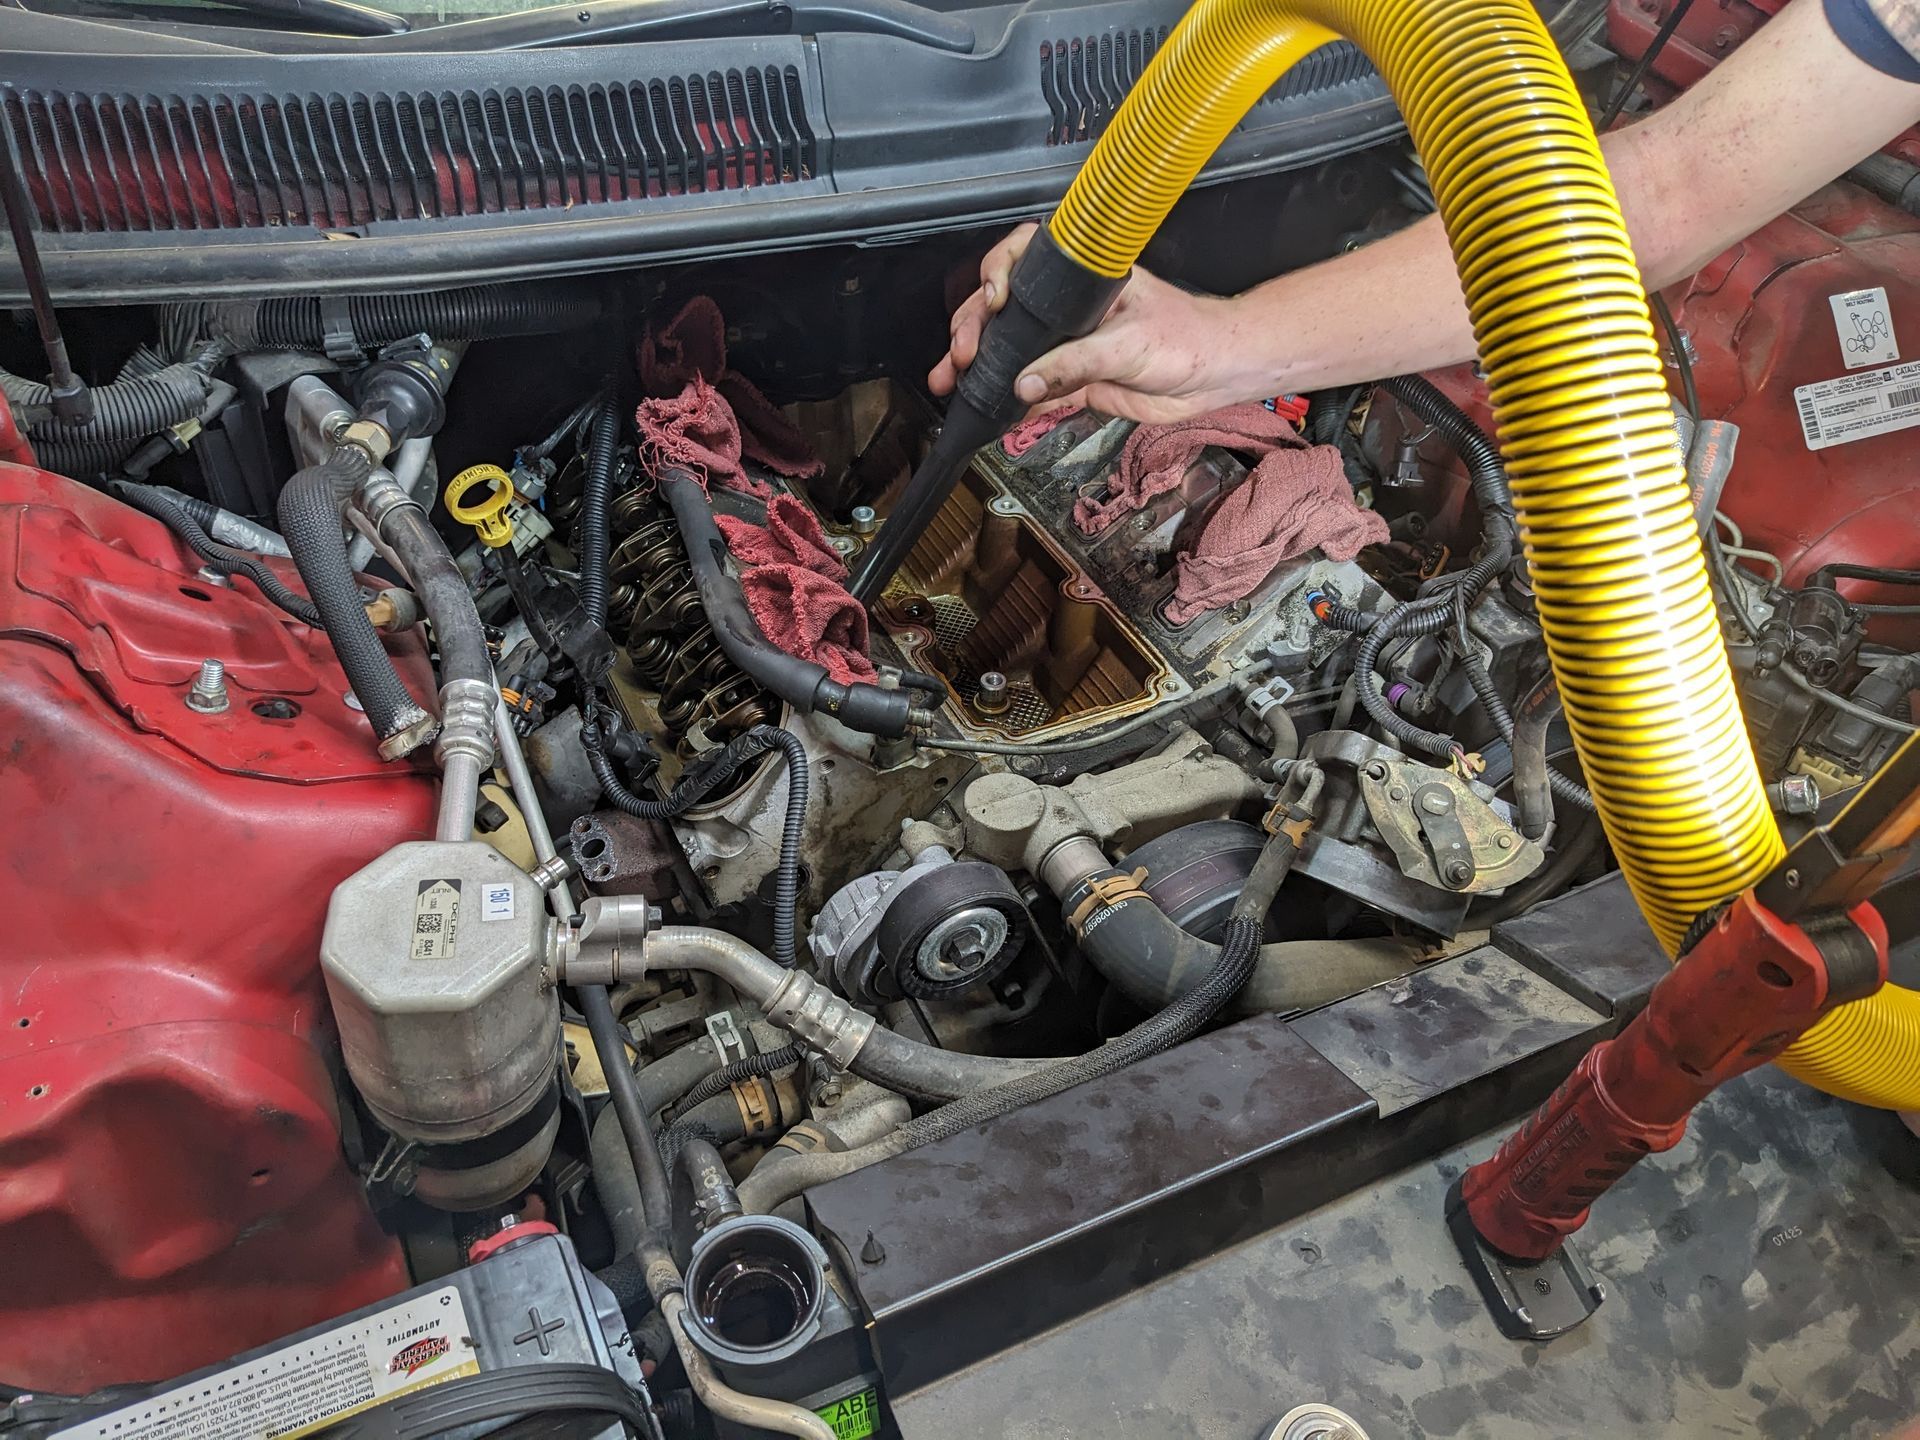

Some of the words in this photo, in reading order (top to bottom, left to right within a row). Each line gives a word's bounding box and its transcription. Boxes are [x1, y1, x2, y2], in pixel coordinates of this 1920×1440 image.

[490, 888, 510, 904] 150
[448, 902, 458, 944] DELPHI
[424, 940, 434, 956] 8341
[385, 1318, 442, 1346] AUTOMOTIVE
[336, 1346, 356, 1358] limited
[358, 1350, 367, 1358] To
[391, 1337, 447, 1364] BATTERIES
[335, 1352, 359, 1367] replace
[390, 1344, 450, 1373] INTERSTATE
[316, 1362, 336, 1374] under
[332, 1359, 369, 1379] Distributed
[287, 1368, 317, 1385] warranty,
[322, 1372, 333, 1383] by
[344, 1369, 371, 1384] chemicals
[354, 1376, 373, 1388] known
[217, 1384, 226, 1392] AP
[267, 1383, 281, 1393] U.S.
[280, 1380, 288, 1388] in
[292, 1377, 324, 1395] Interstate
[326, 1380, 345, 1392] known
[338, 1386, 348, 1394] the
[355, 1383, 374, 1396] Battery
[256, 1388, 268, 1398] call
[261, 1389, 292, 1406] Batteries,
[296, 1393, 310, 1403] state
[310, 1389, 320, 1398] the
[324, 1390, 338, 1400] state
[238, 1400, 261, 1415] Dallas,
[264, 1401, 291, 1416] California
[292, 1398, 319, 1412] California
[313, 1398, 339, 1412] terminals
[319, 1391, 376, 1418] PROPOSITION
[836, 1390, 877, 1421] ABE
[177, 1405, 203, 1419] Interstate
[200, 1411, 208, 1419] in
[228, 1410, 238, 1419] TX
[283, 1412, 302, 1424] related
[302, 1408, 313, 1417] and
[175, 1413, 201, 1429] Canada
[205, 1414, 229, 1428] 75251
[308, 1414, 319, 1423] 65
[163, 1423, 176, 1434] call
[189, 1422, 206, 1434] USA
[206, 1427, 222, 1438] Wash
[240, 1424, 252, 1432] and
[266, 1418, 307, 1439] WARNING
